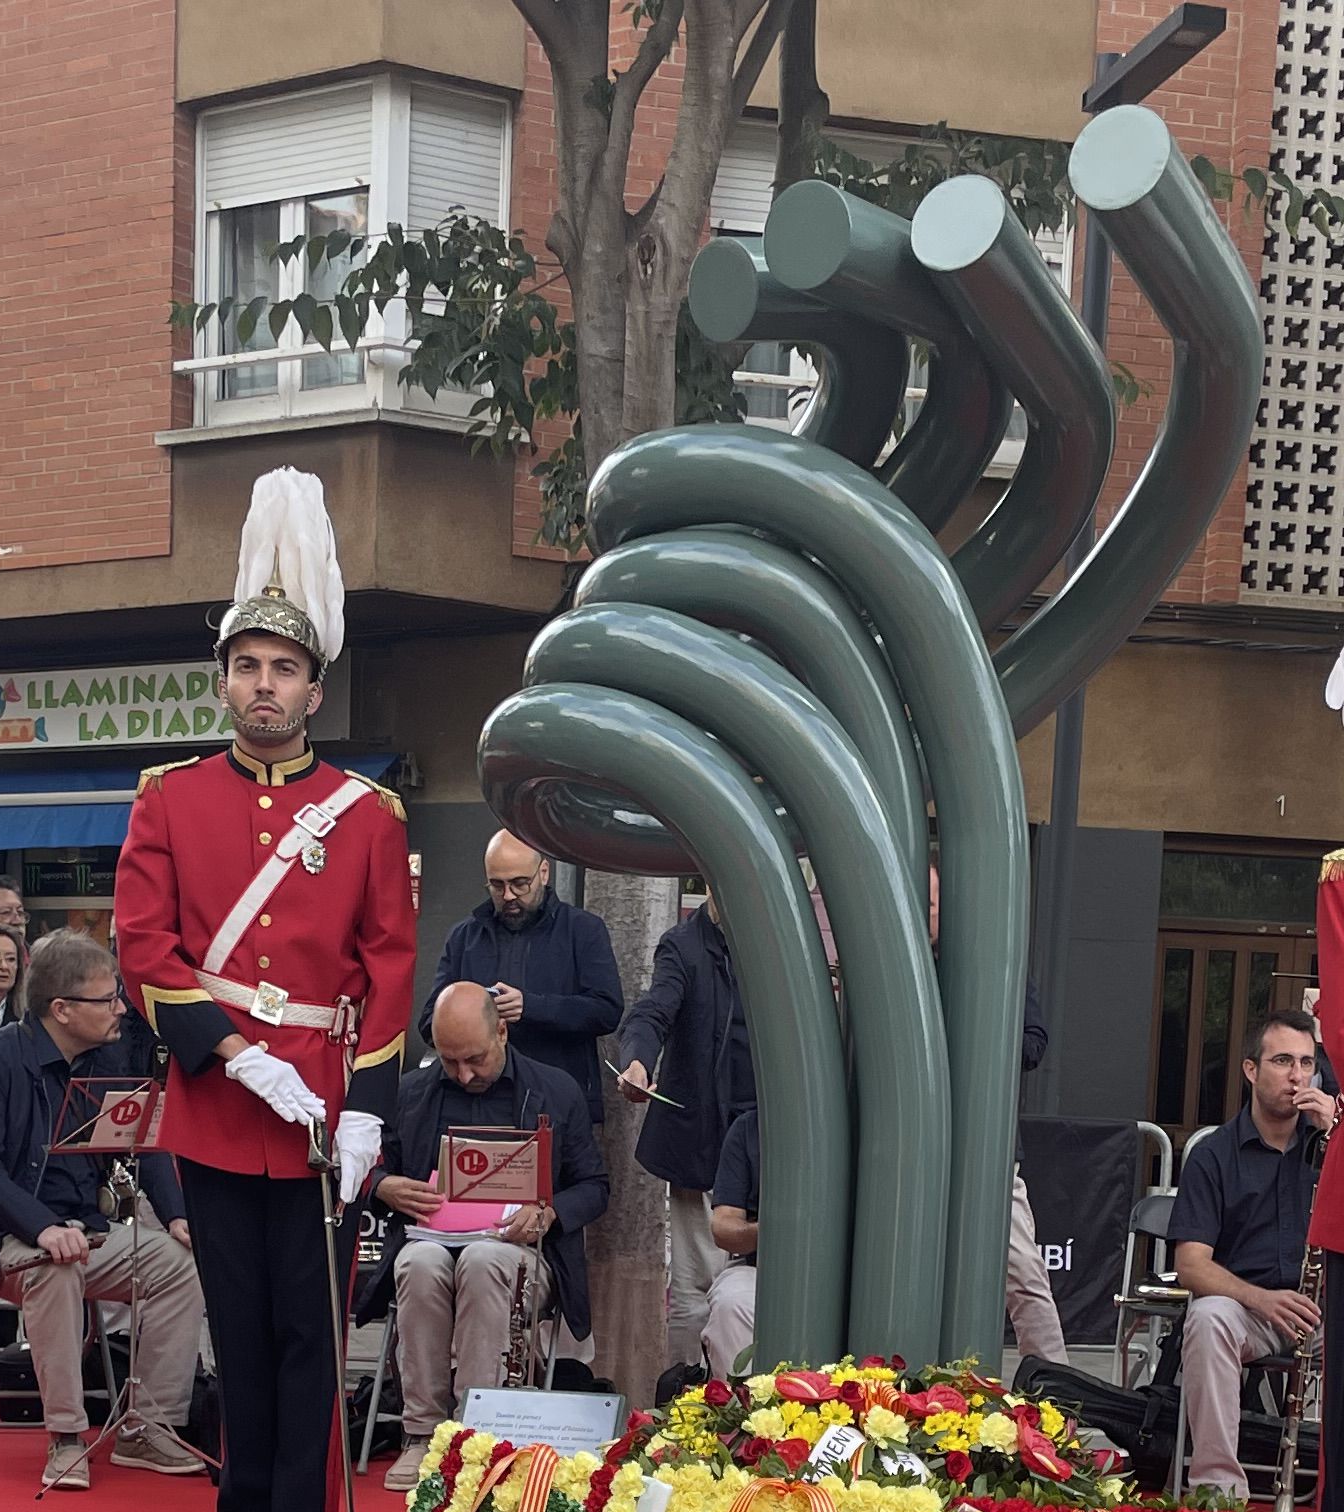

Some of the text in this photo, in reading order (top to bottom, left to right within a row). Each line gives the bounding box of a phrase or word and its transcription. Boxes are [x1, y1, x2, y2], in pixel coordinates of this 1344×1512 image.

[79, 706, 236, 741] LA DIADA
[1276, 795, 1284, 816] 1
